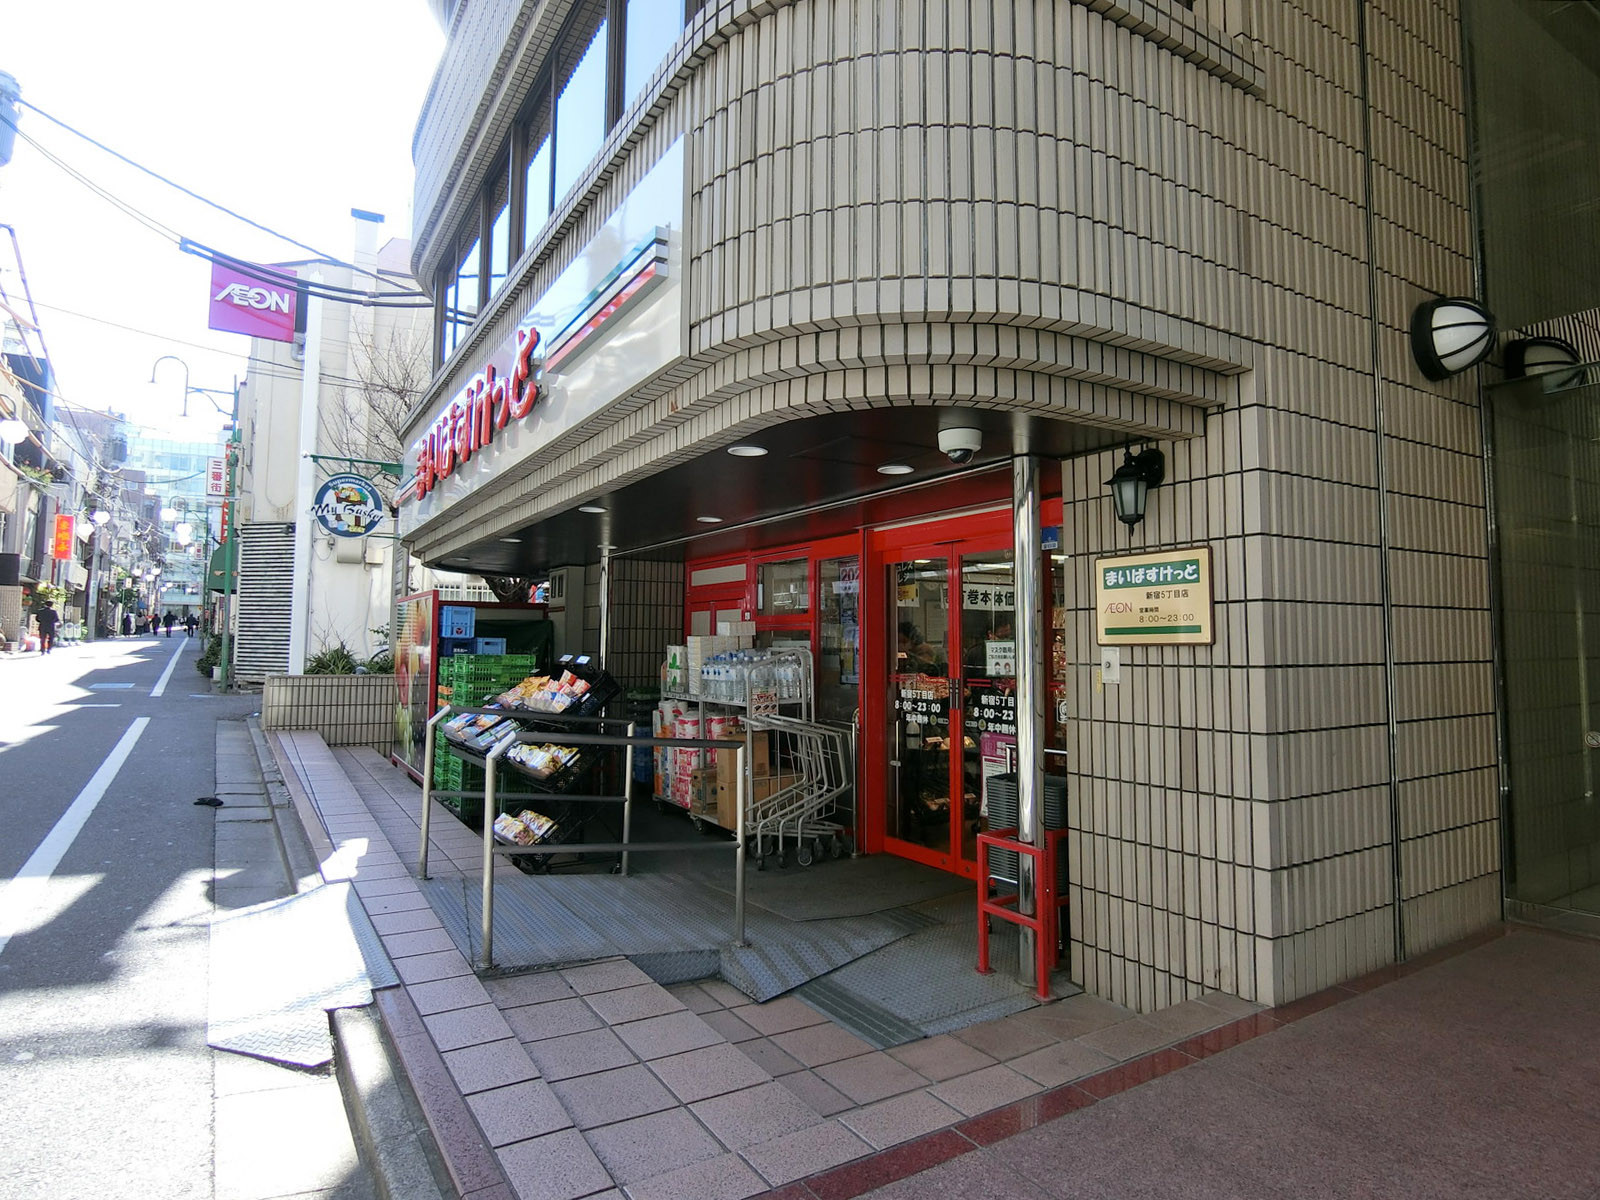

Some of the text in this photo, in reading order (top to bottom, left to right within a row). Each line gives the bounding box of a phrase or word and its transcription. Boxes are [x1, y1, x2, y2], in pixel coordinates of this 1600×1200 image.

[416, 327, 540, 501] まいばすけっと
[211, 460, 223, 492] 三番街
[328, 477, 372, 491] Supermarket
[311, 503, 337, 516] My
[1105, 564, 1198, 586] まいばすけっと
[1146, 589, 1189, 600] 新宿5丁目店
[901, 689, 934, 700] 新宿5丁目店
